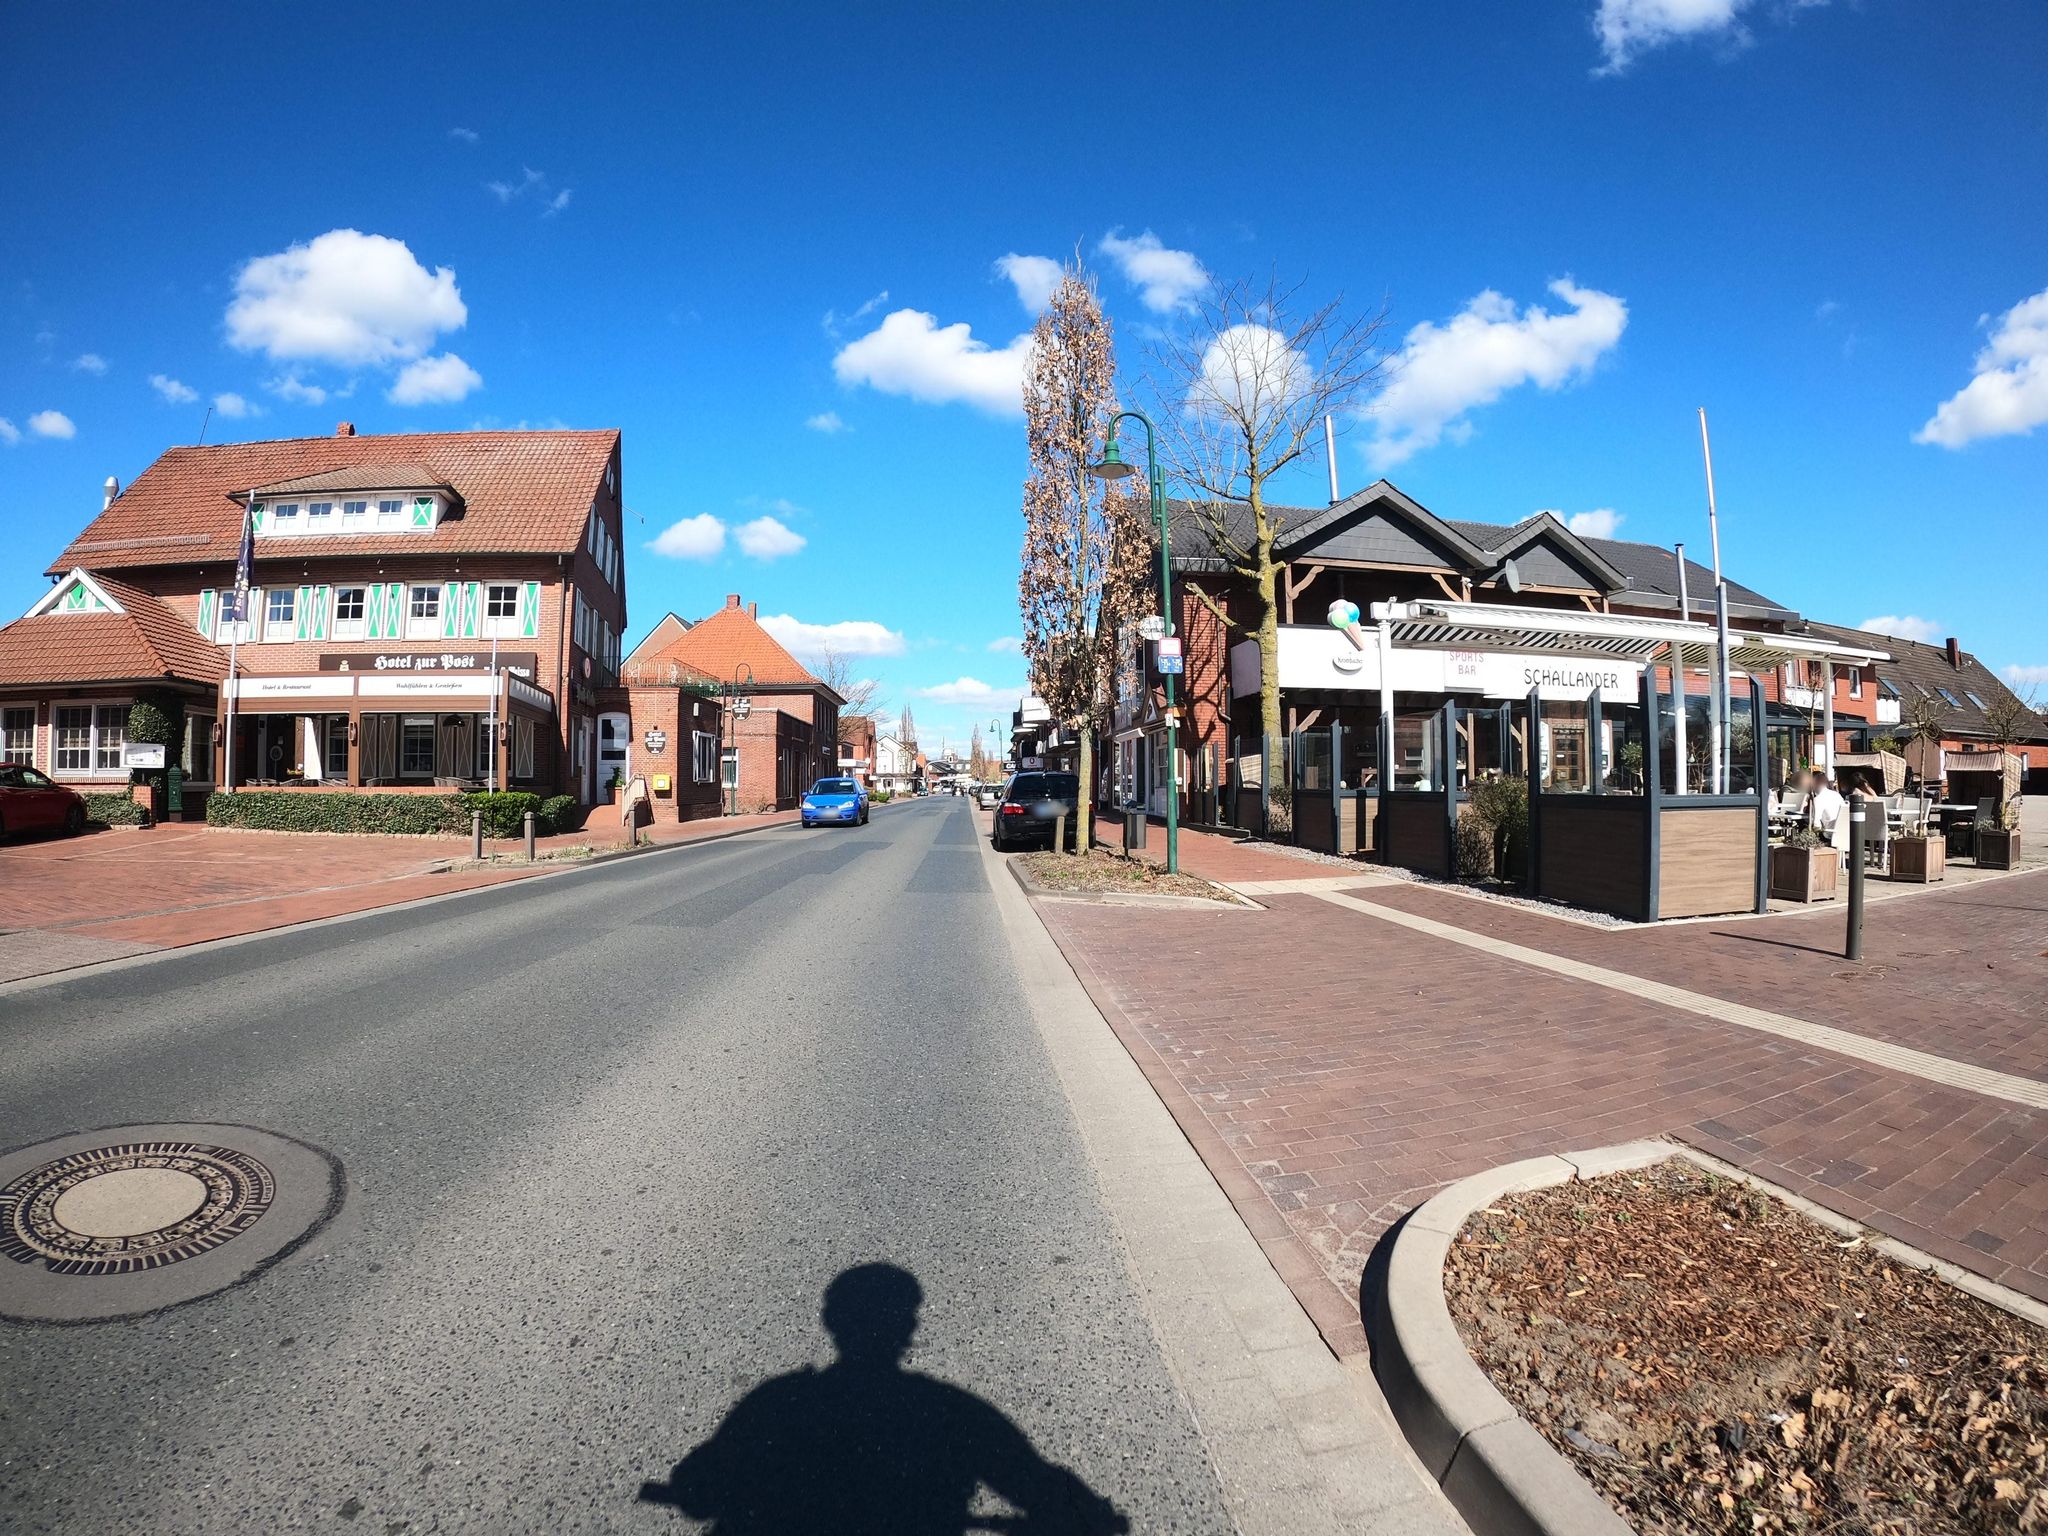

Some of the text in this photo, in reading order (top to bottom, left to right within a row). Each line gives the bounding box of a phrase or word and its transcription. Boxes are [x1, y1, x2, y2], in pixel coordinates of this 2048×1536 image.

[374, 654, 475, 671] Hotel zur Post
[1449, 651, 1484, 663] SPORTS
[1458, 664, 1476, 676] BAR
[1524, 668, 1619, 689] SCHALLANDER
